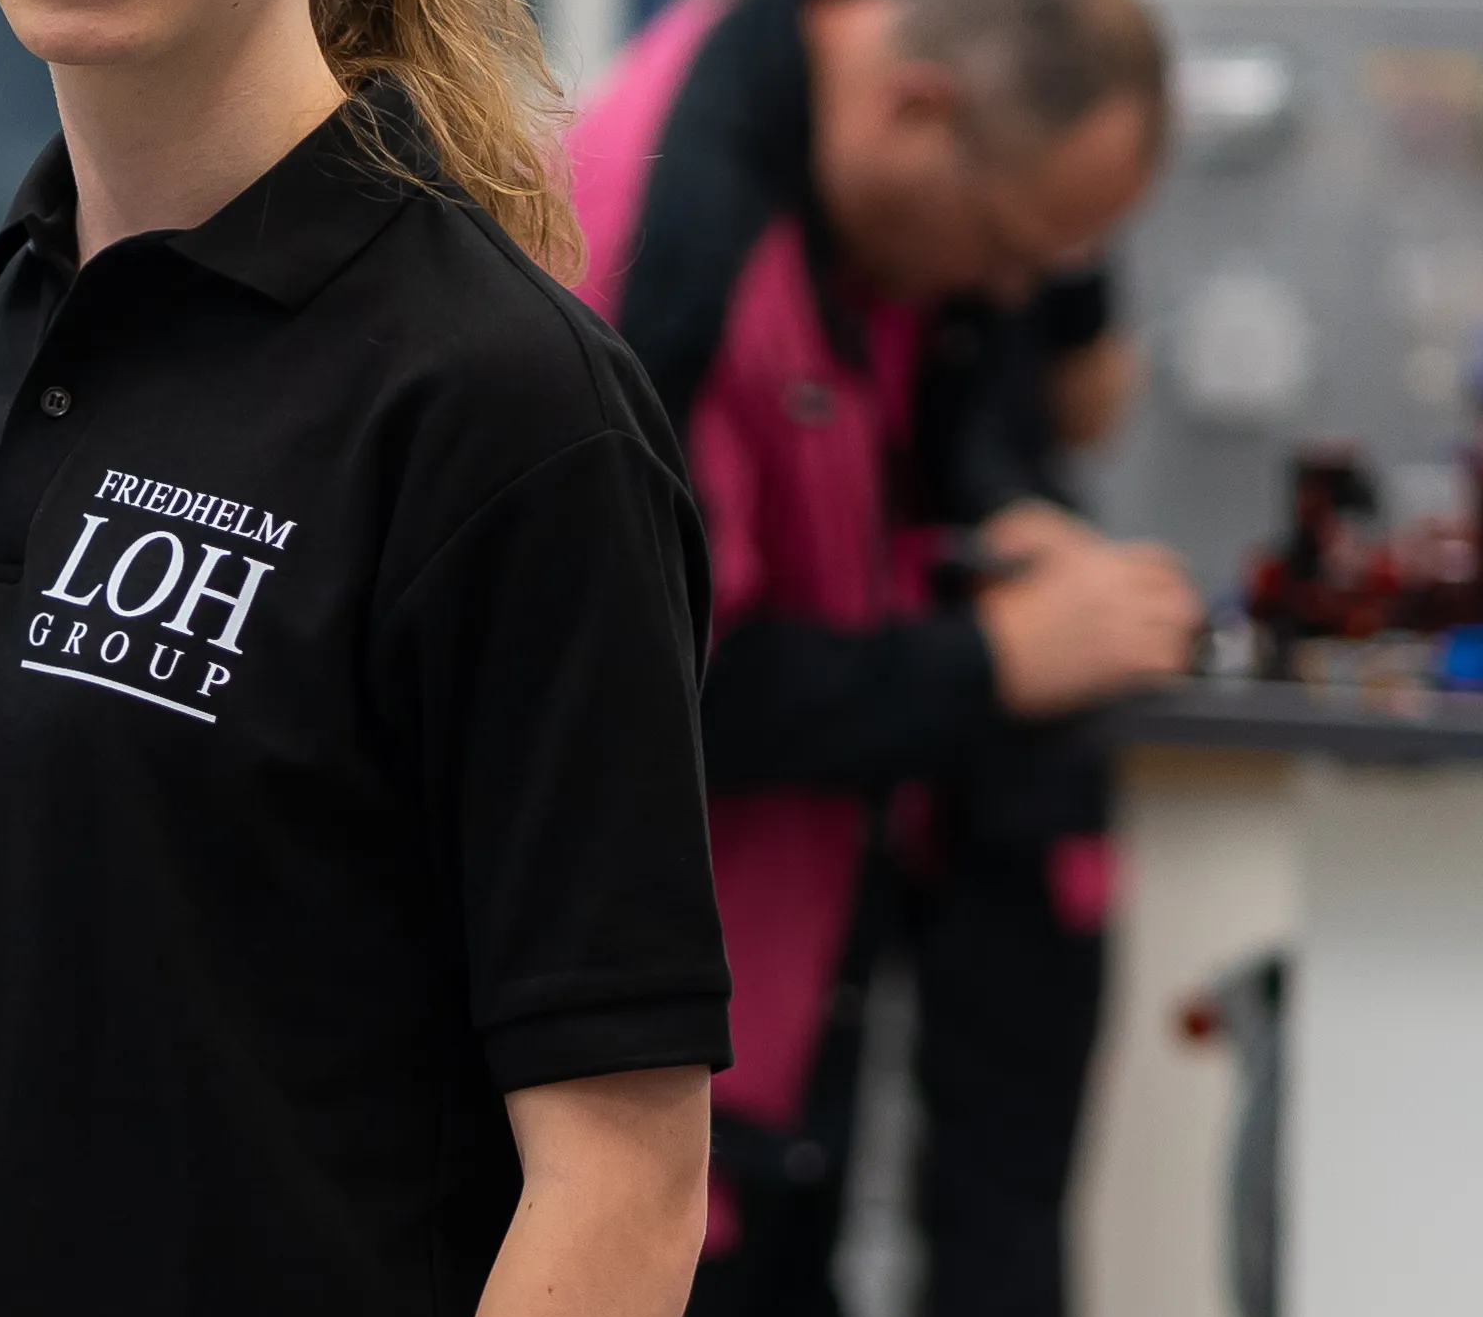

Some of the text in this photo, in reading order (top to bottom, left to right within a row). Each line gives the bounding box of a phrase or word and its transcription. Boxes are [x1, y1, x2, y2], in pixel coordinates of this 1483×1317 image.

[94, 469, 298, 550] FRIEDHELM
[41, 513, 276, 654] LOH
[28, 612, 231, 697] GROUP
